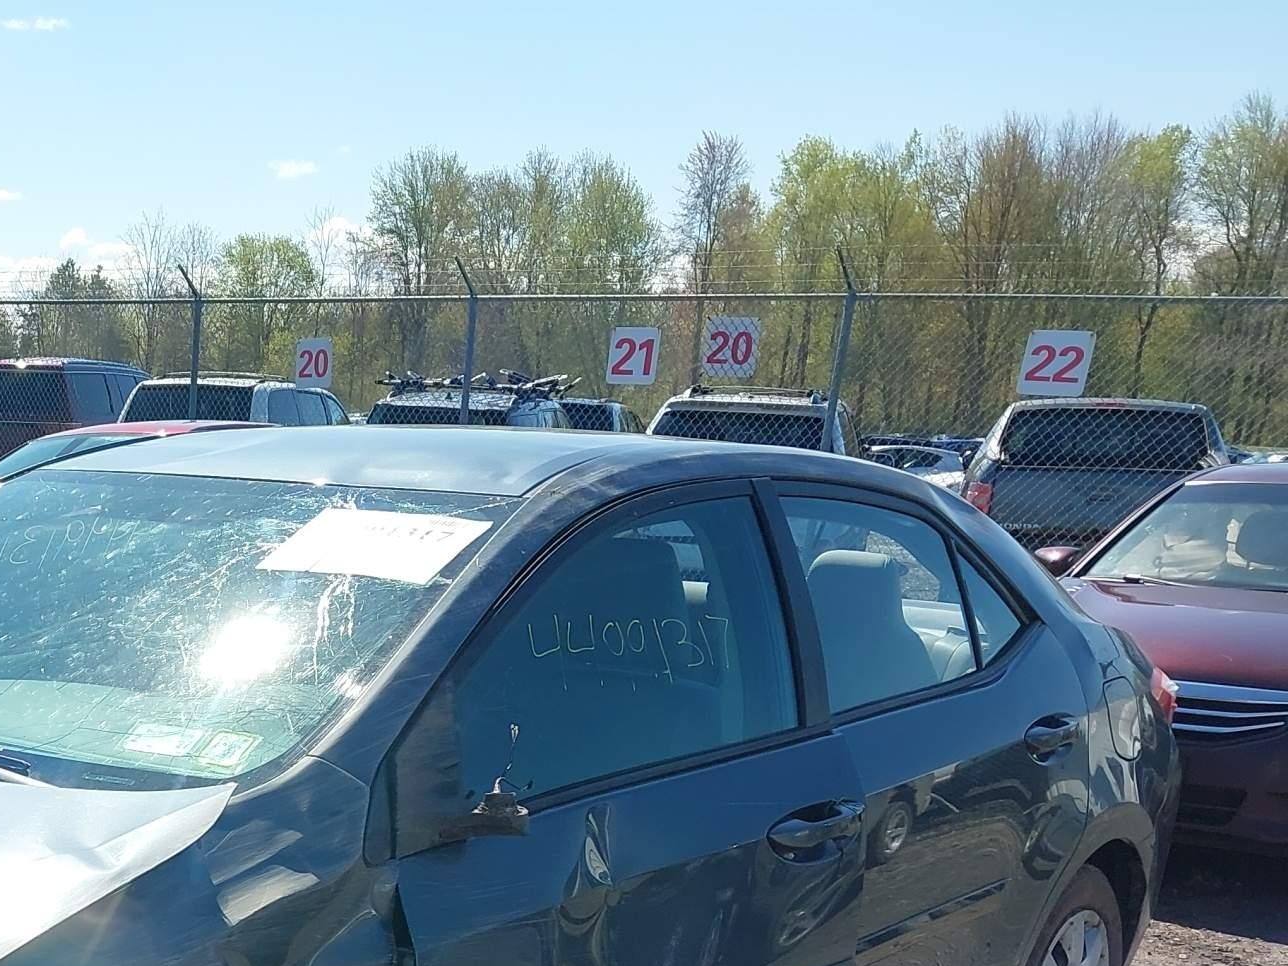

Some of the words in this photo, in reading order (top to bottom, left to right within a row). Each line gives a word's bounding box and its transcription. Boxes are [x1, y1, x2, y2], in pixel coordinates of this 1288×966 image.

[298, 349, 329, 378] 20
[610, 337, 655, 376] 21
[705, 331, 753, 366] 20
[1024, 344, 1085, 384] 22
[1000, 522, 1040, 530] ONDA
